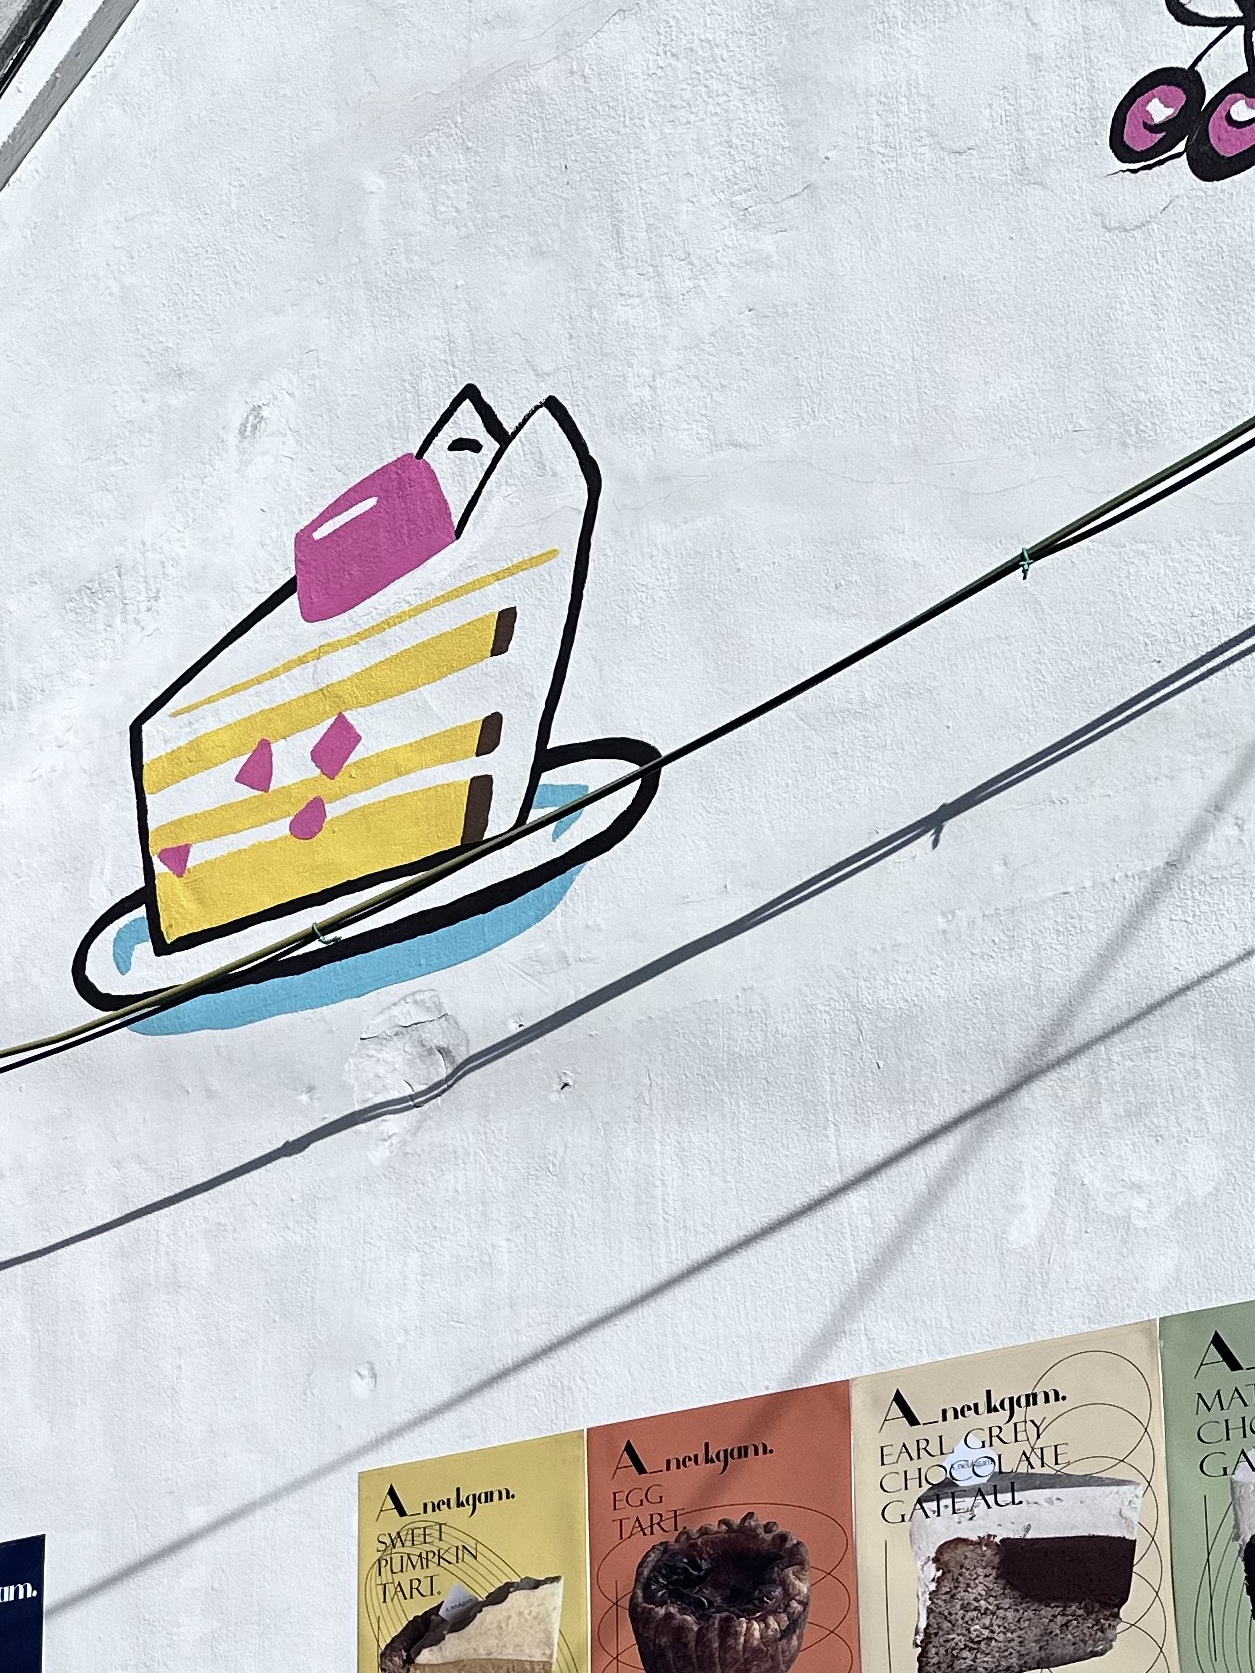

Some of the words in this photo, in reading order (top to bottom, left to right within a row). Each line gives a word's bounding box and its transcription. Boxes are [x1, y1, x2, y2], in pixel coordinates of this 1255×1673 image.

[879, 1434, 955, 1466] EARL
[963, 1416, 1047, 1450] GREY
[879, 1442, 1070, 1494] CHOCOLATE
[611, 1483, 664, 1511] EGG
[881, 1481, 1024, 1524] GATEAU.
[376, 1521, 447, 1553] SWEET
[611, 1507, 688, 1541] TART.
[376, 1541, 479, 1578] PUMPKIN
[375, 1573, 442, 1604] TART.
